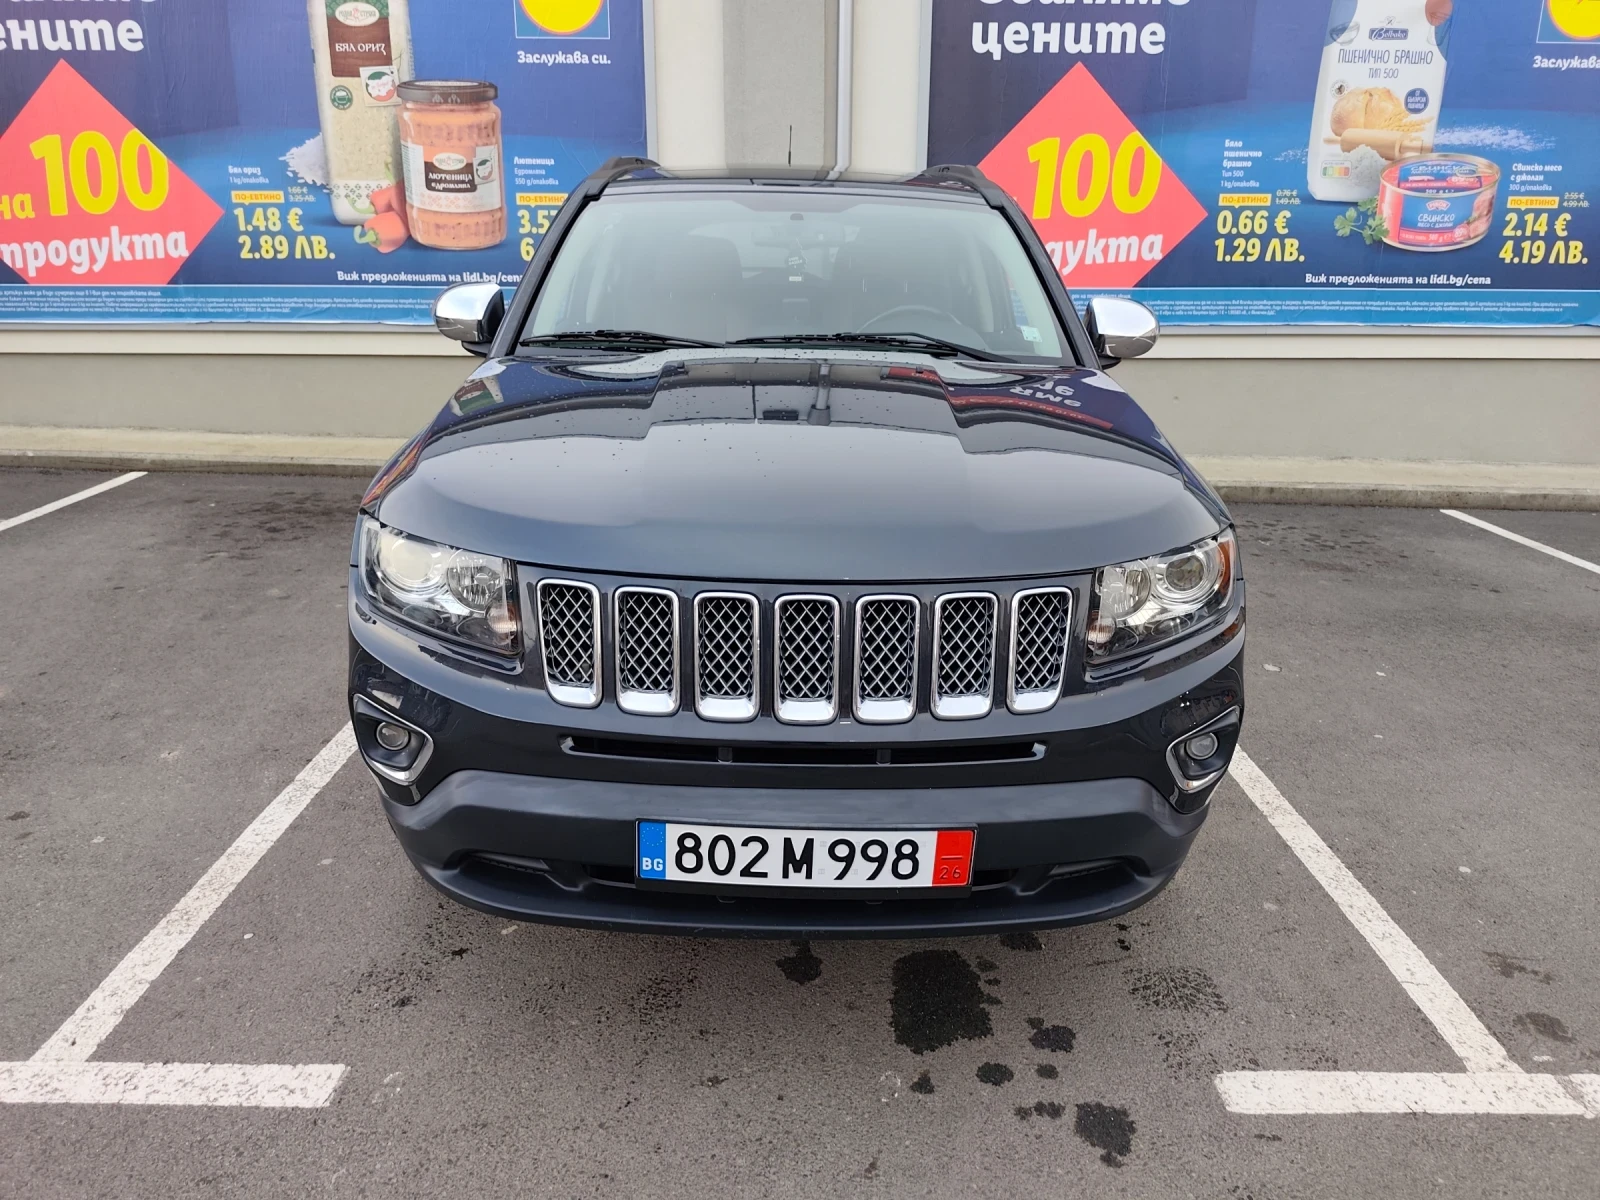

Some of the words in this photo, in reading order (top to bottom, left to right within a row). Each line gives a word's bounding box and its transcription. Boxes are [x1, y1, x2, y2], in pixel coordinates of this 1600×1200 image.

[0, 19, 144, 51] ните
[971, 21, 1165, 60] цените
[335, 43, 356, 52] БЯЛ
[357, 43, 386, 56] ОРИЗ
[1338, 48, 1391, 64] ПШЕНИЧНО
[1394, 49, 1434, 65] БРАШНО
[517, 51, 589, 66] Заслужава
[591, 53, 611, 64] си.
[1368, 67, 1382, 79] ТИП
[1383, 68, 1399, 79] 500
[1224, 139, 1243, 148] Бяло
[513, 156, 555, 166] Лютеница
[1223, 150, 1263, 158] пшенично
[228, 165, 242, 174] Бял
[243, 166, 262, 176] ориз
[1222, 159, 1252, 168] брашно
[1512, 163, 1543, 171] Свинско
[29, 128, 169, 216] 100
[1027, 130, 1163, 219] 100
[1222, 170, 1232, 178] Тип
[1233, 170, 1244, 178] 500
[1516, 173, 1544, 183] джолан
[234, 193, 282, 201] ПО-ЕВТИНО
[1221, 196, 1269, 204] ПО-ЕВТИНО
[233, 207, 282, 232] 1.48
[287, 207, 304, 232] €
[517, 208, 559, 234] 3.5
[1216, 209, 1269, 235] 0.66
[1274, 210, 1292, 235] €
[1417, 213, 1455, 222] СВИНСКО
[1502, 212, 1549, 237] 2.14
[1554, 212, 1572, 237] €
[0, 226, 189, 277] продукта
[238, 234, 289, 259] 2.89
[294, 235, 336, 260] ЛВ.
[1214, 237, 1261, 262] 1.29
[1264, 238, 1305, 262] ЛВ.
[1499, 239, 1546, 264] 4.19
[1548, 240, 1588, 265] ЛВ.
[336, 271, 359, 281] Виж
[361, 272, 447, 283] предложенията
[449, 274, 461, 282] на
[1305, 273, 1327, 283] Виж
[1329, 275, 1413, 286] предложенията
[1429, 274, 1491, 286] lidl.bg/cena
[675, 832, 769, 879] 802
[782, 837, 815, 880] M
[827, 838, 920, 881] 998
[642, 857, 664, 871] BG
[940, 865, 961, 880] 26
